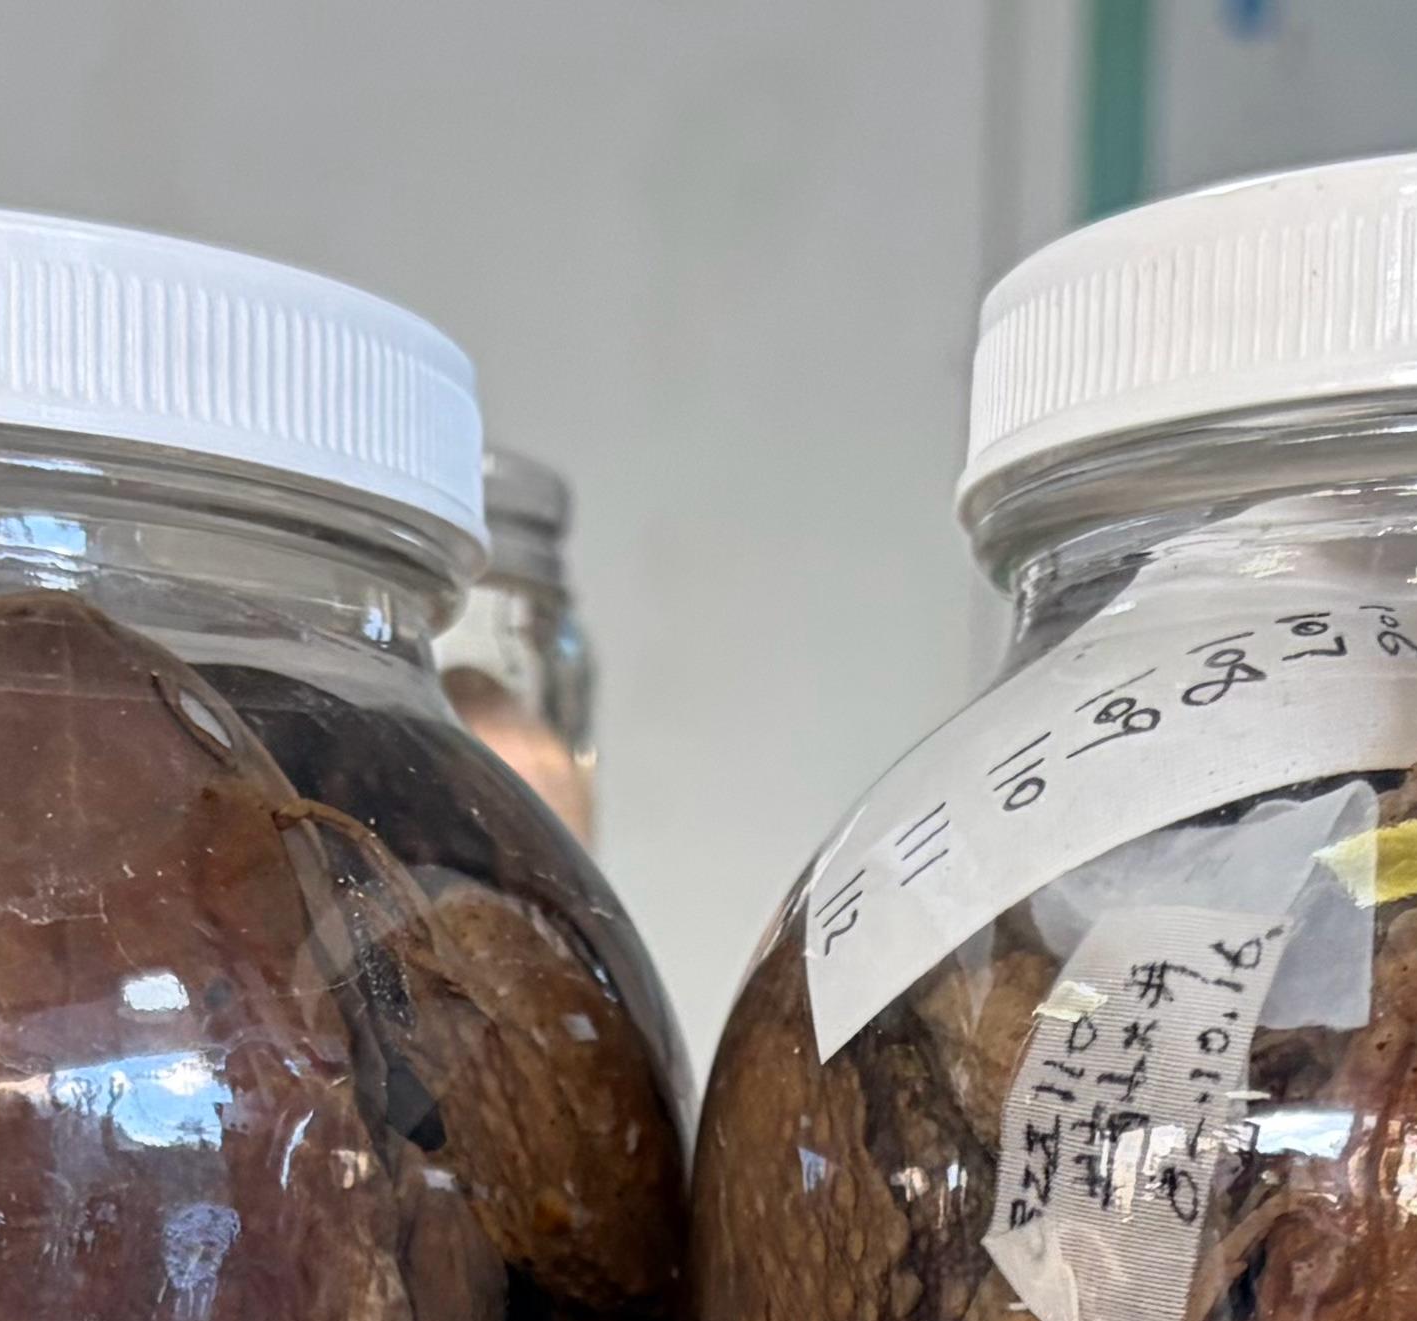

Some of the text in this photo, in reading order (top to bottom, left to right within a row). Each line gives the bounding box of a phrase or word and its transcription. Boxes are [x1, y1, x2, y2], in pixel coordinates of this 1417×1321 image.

[1180, 631, 1267, 708] 108
[1275, 611, 1349, 662] 107
[1065, 667, 1162, 760] 109
[986, 731, 1052, 813] 110
[814, 869, 868, 957] 112
